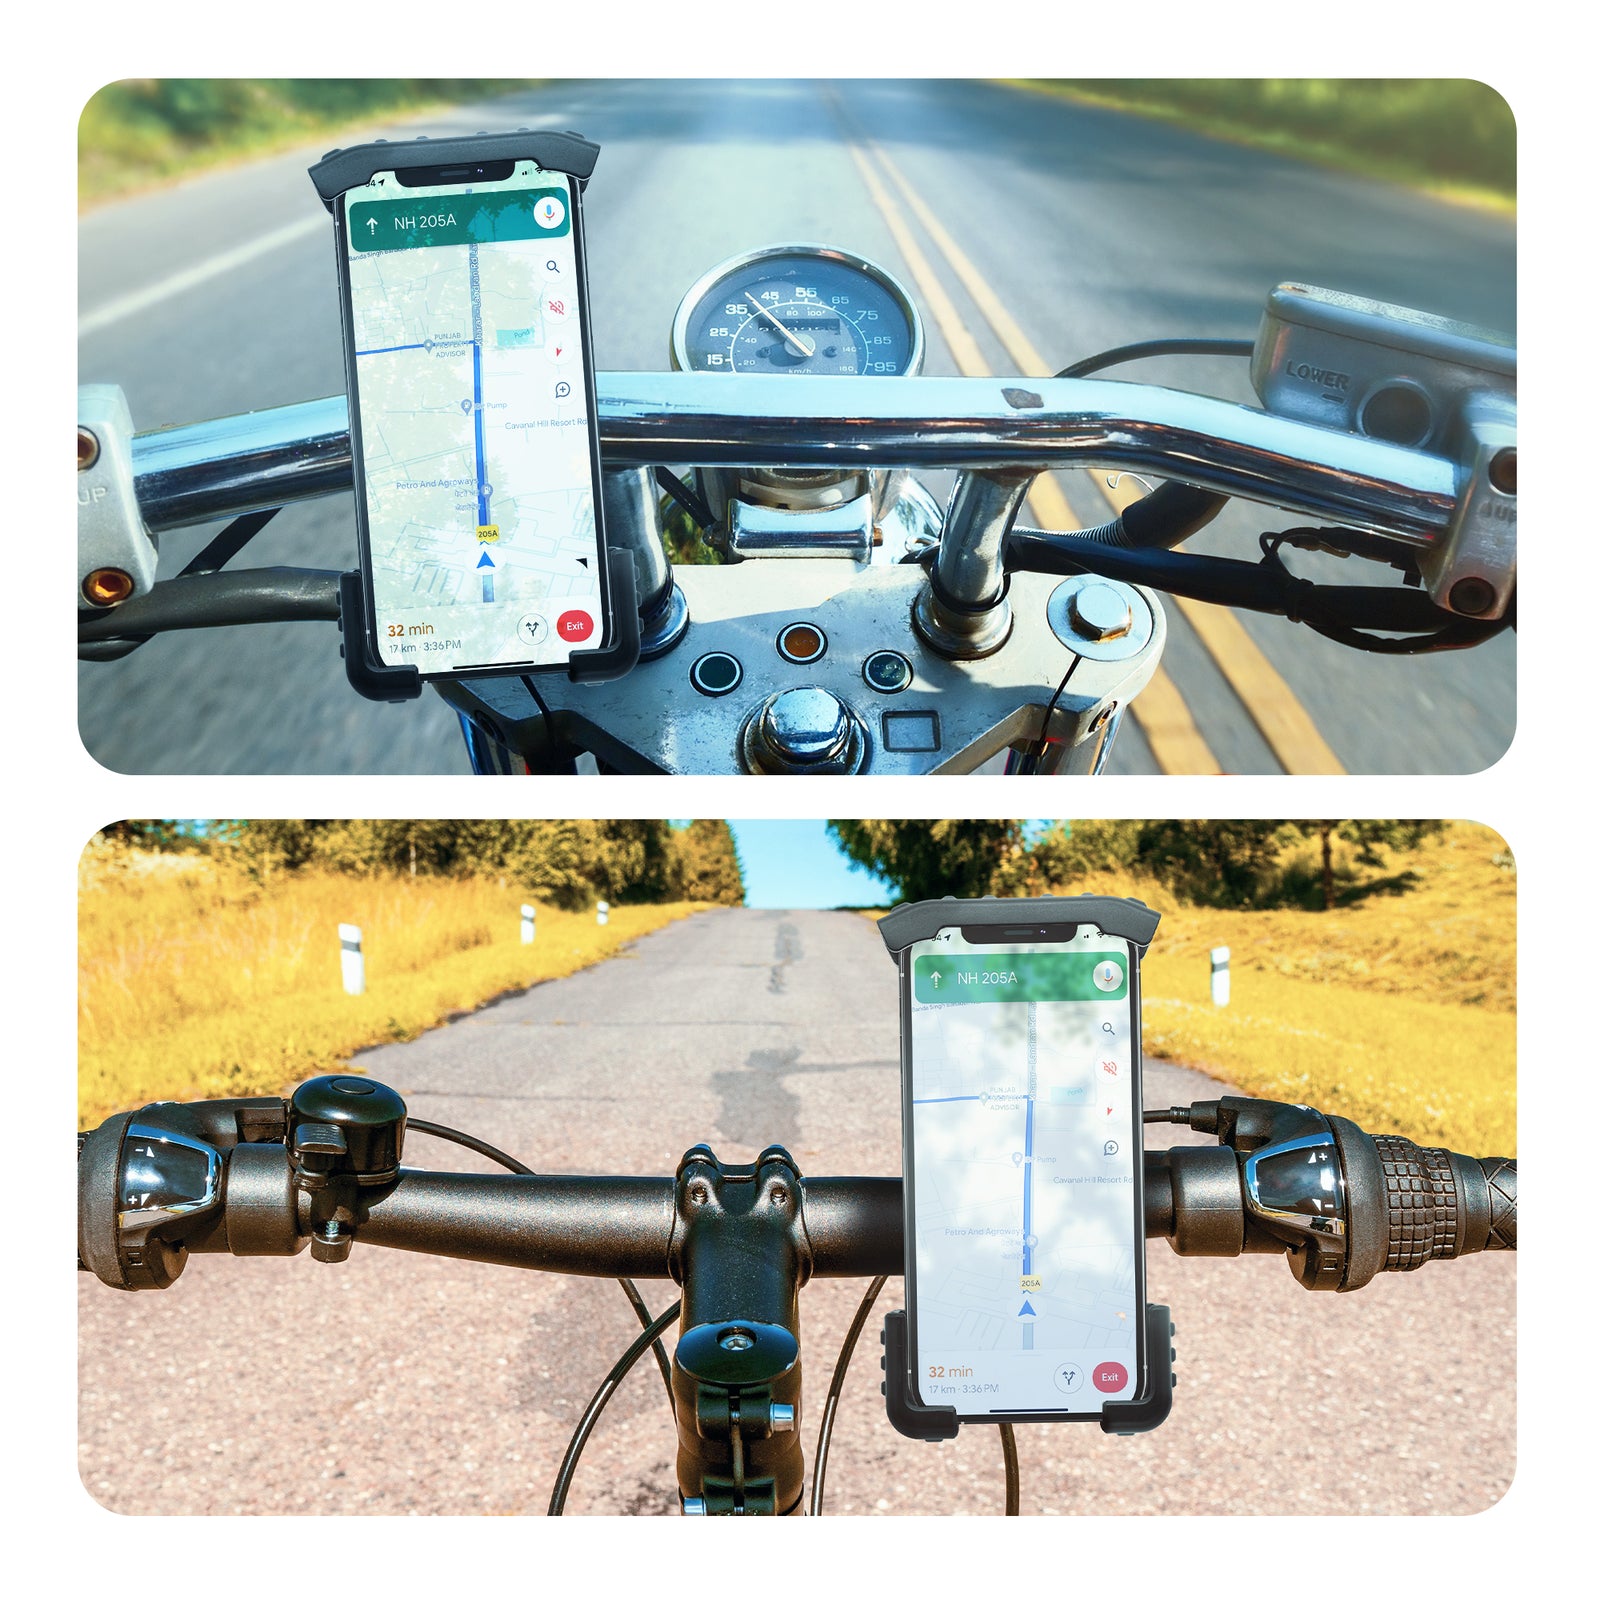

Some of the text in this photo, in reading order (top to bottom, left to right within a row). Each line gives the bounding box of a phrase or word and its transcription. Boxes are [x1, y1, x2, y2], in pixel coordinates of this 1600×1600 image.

[394, 213, 456, 230] NH 205A
[470, 257, 479, 269] Rd
[760, 291, 780, 301] 45
[795, 287, 818, 298] 55
[725, 303, 748, 315] 35
[856, 310, 879, 321] 75
[434, 332, 461, 340] PUNJAB
[709, 328, 729, 337] 25
[436, 350, 466, 358] ADVISOR
[707, 354, 724, 365] 15
[874, 362, 897, 373] 95
[1285, 359, 1349, 391] LOWER
[486, 402, 507, 410] Pump
[505, 421, 535, 430] Cavanal
[537, 420, 549, 428] Hill
[550, 418, 576, 427] Resort
[396, 482, 419, 490] Petro
[420, 480, 437, 488] And
[478, 530, 498, 538] 205A
[388, 622, 434, 637] 32 min
[566, 620, 584, 631] Exit
[389, 644, 398, 653] 17
[401, 643, 416, 653] km
[957, 971, 1018, 985] NH 205A
[1097, 1176, 1122, 1184] Resort
[967, 1227, 984, 1235] And
[928, 1365, 973, 1378] 32 min
[1101, 1372, 1119, 1382] Exit
[929, 1385, 938, 1394] 17
[941, 1385, 956, 1394] km
